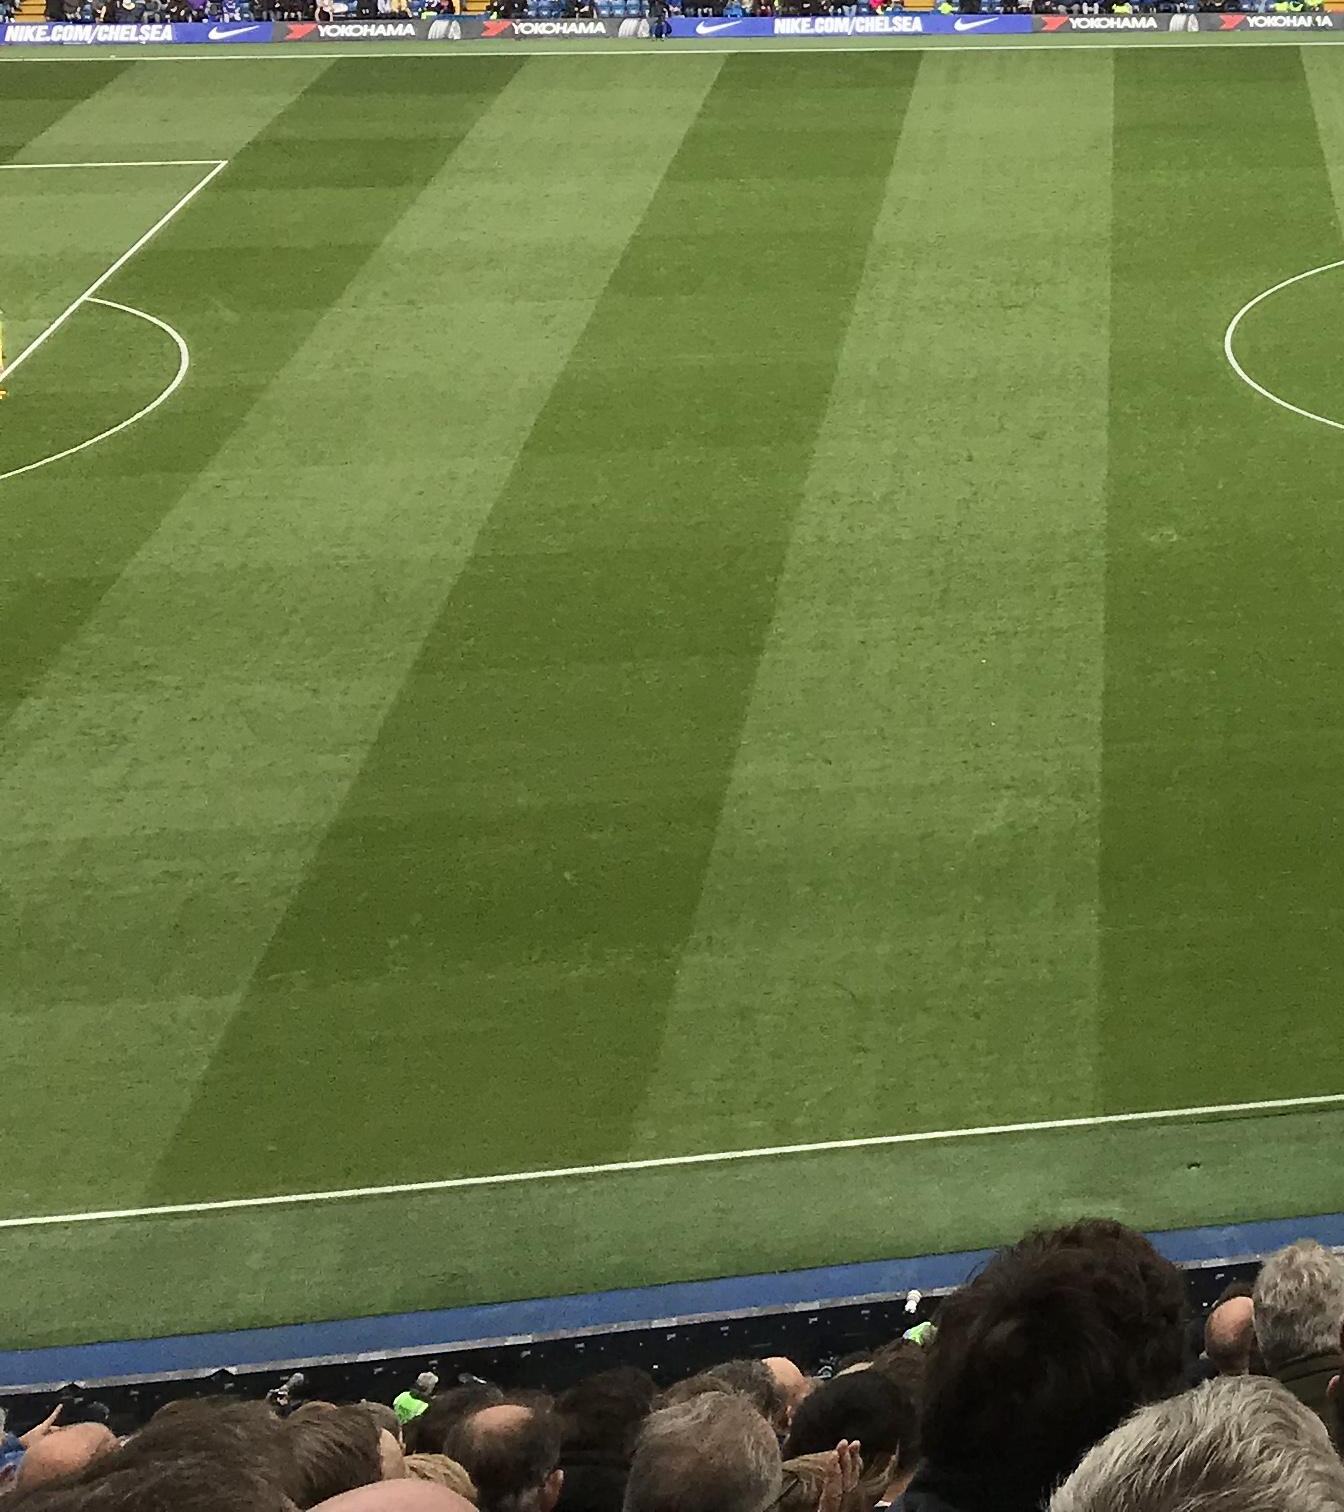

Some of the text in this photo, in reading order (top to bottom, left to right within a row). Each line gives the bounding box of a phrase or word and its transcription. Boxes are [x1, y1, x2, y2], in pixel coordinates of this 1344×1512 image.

[512, 22, 607, 35] YOKOHAMA
[773, 16, 923, 35] NIKE.COM/CHELSEA
[1069, 16, 1158, 29] YOKOHAMA
[4, 24, 173, 44] NIKE.COM/CHELSEA
[316, 23, 416, 37] YOKOHAMA
